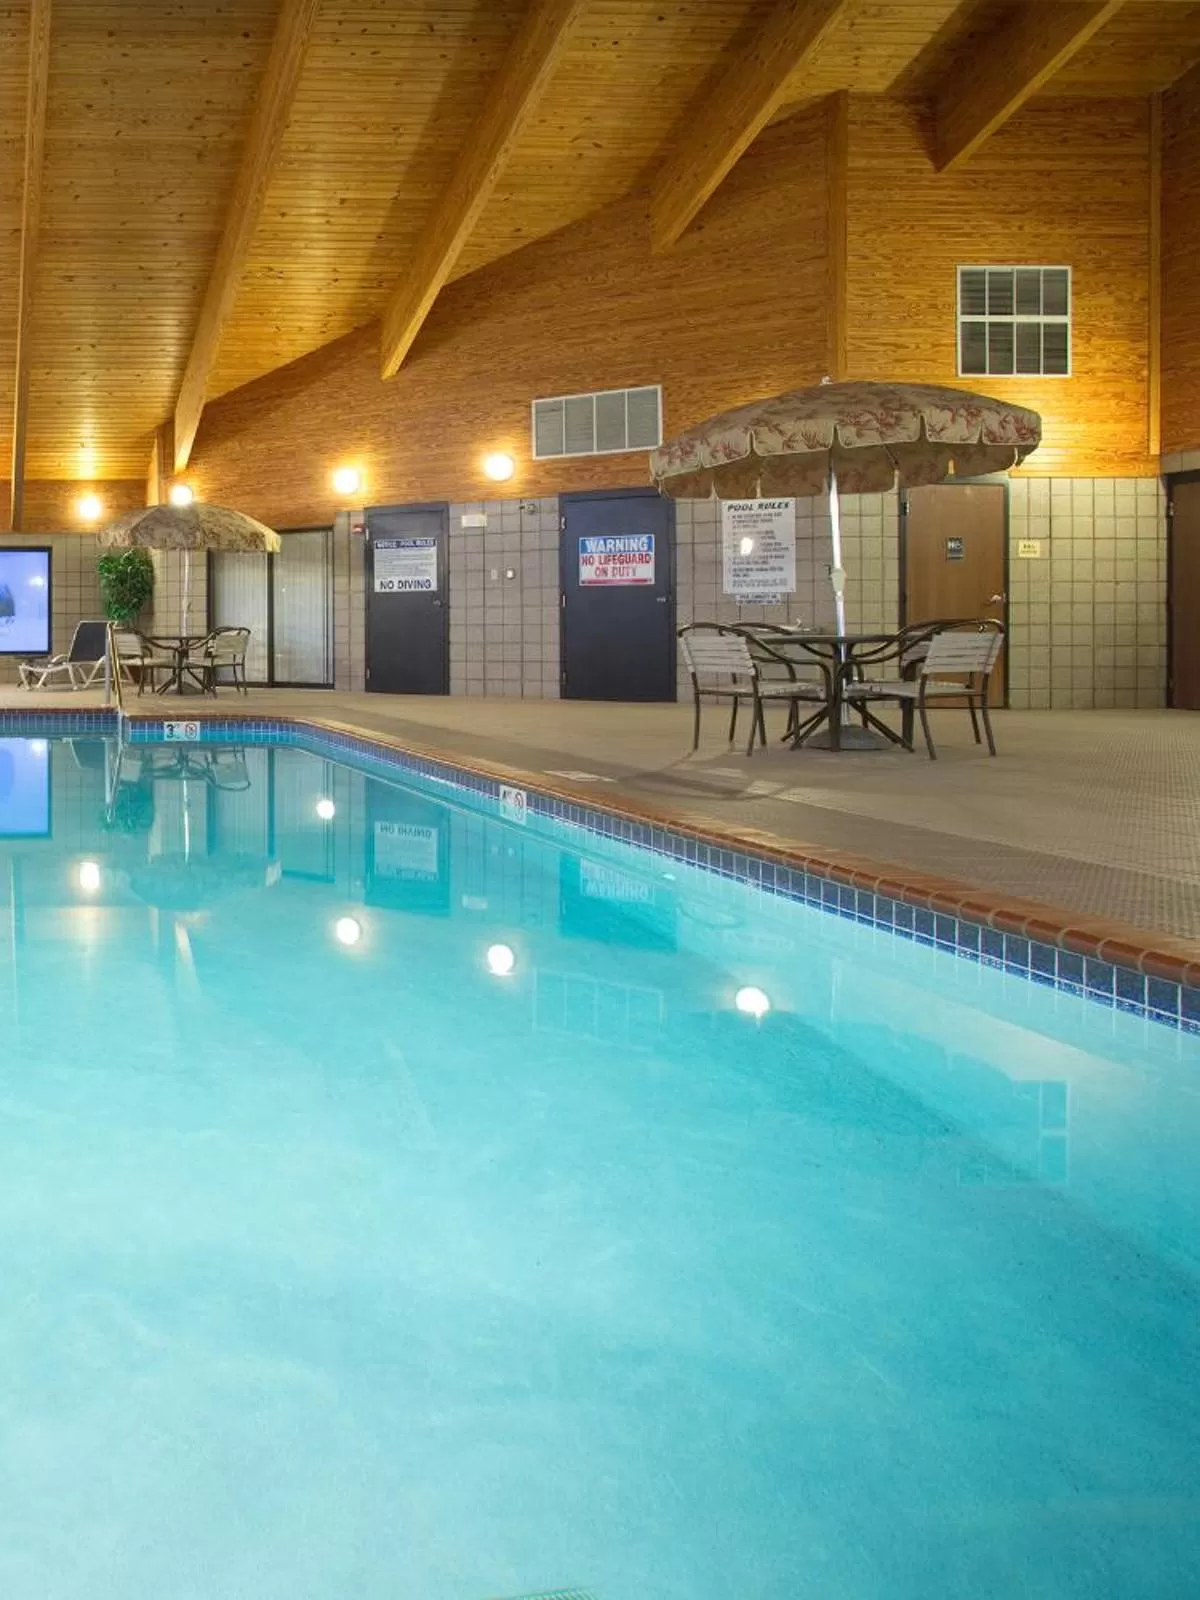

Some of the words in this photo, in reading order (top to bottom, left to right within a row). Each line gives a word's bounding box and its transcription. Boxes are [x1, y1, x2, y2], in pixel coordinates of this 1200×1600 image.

[728, 503, 753, 512] POOL
[757, 502, 789, 510] RULES
[586, 537, 648, 552] WARNING
[582, 554, 594, 566] NO
[598, 553, 652, 565] LIFEGUARD
[595, 566, 608, 577] ON
[612, 566, 637, 577] DUTY
[380, 580, 394, 589] NO
[397, 579, 431, 589] DIVING
[166, 724, 174, 739] 3
